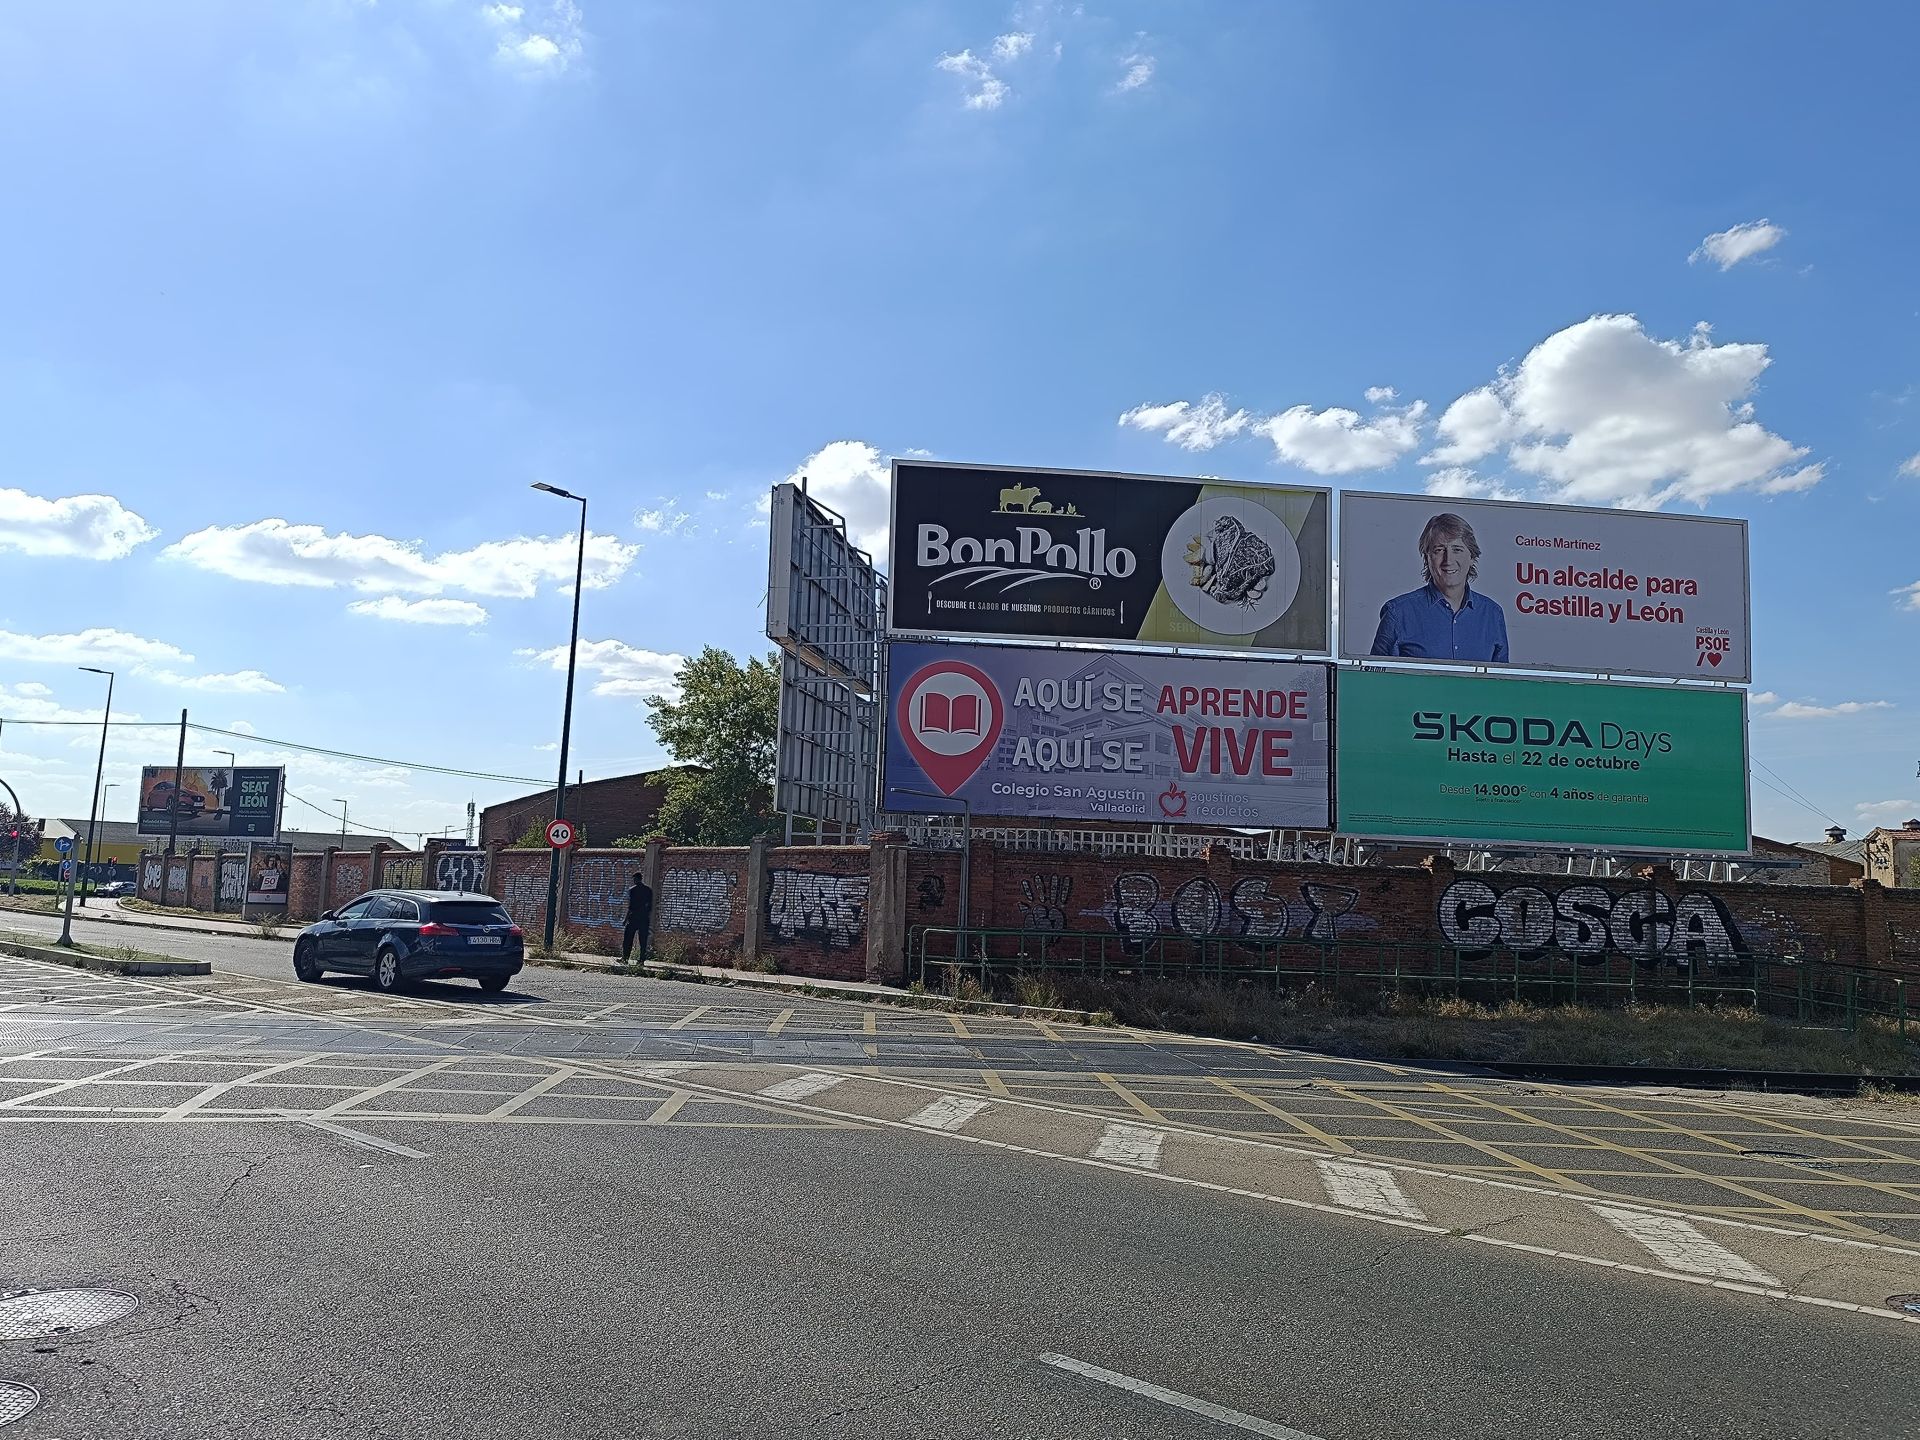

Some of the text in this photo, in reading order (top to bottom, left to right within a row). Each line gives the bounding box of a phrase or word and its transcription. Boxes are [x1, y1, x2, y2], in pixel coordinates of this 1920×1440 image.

[917, 523, 1137, 578] BonPollo
[1515, 535, 1601, 551] Carlos Martínez
[1516, 562, 1698, 597] Un alcalde para
[936, 599, 967, 610] DESCUBRE
[968, 601, 976, 610] EL
[977, 601, 1000, 611] SABOR
[1001, 602, 1010, 612] DE
[1011, 603, 1042, 613] NUESTROS
[1043, 604, 1081, 615] PRODUCTOS
[1515, 591, 1684, 624] Castilla y León
[1696, 635, 1731, 652] PSOE
[1013, 673, 1308, 720] AQUÍ SE APRENDE
[1600, 721, 1672, 759] Days
[1012, 725, 1293, 777] AQUÍ SE VIVE
[1448, 748, 1641, 771] Hasta el 22 de octubre
[241, 781, 270, 793] SEAT
[991, 782, 1145, 802] Colegio San Agustín
[1439, 783, 1471, 795] Desde
[1530, 790, 1547, 799] con
[1550, 787, 1559, 799] 4
[1563, 788, 1595, 801] años
[1597, 791, 1609, 801] de
[1611, 793, 1649, 804] garantía
[239, 792, 269, 808] LEÓN
[1190, 792, 1249, 804] agustinos
[1090, 802, 1146, 814] Valladolid
[1196, 805, 1259, 818] recoletos
[552, 829, 569, 839] 40
[264, 877, 276, 885] 50
